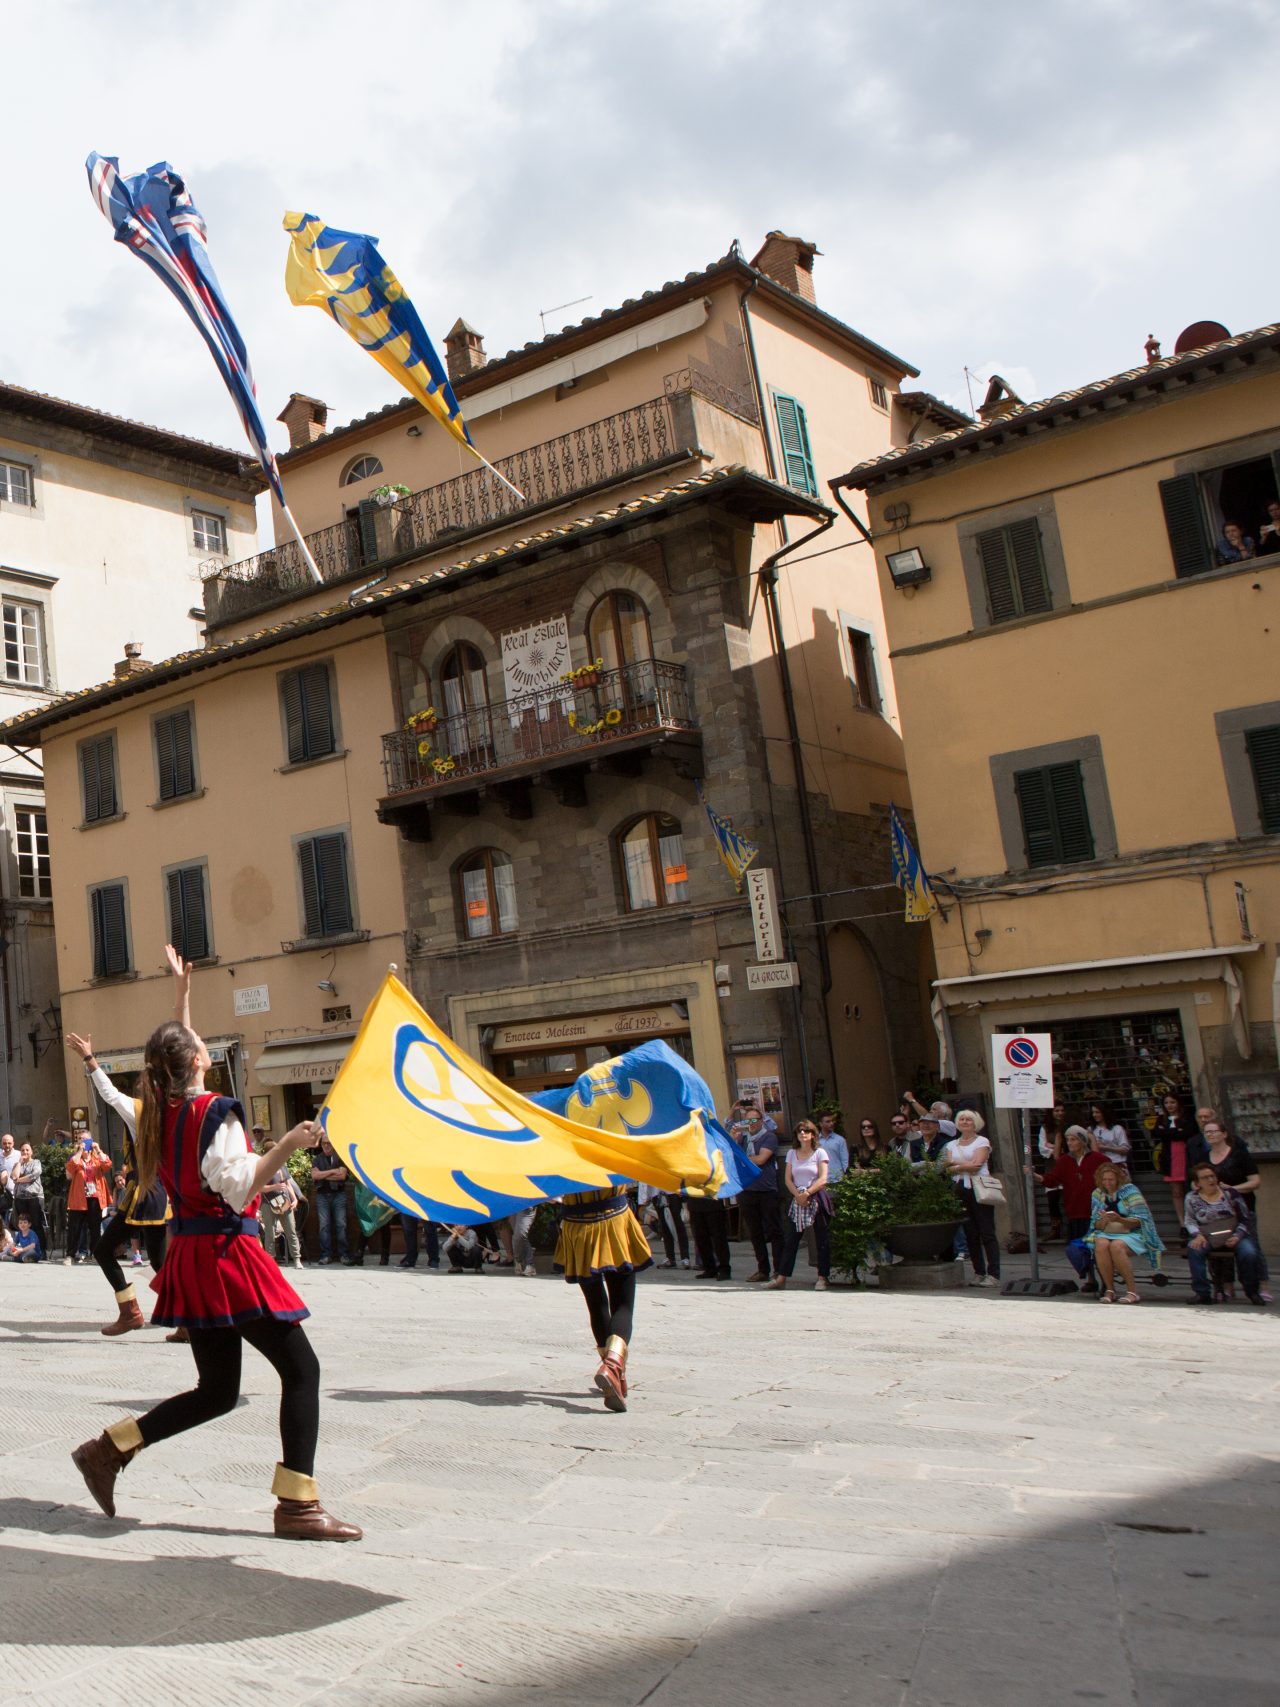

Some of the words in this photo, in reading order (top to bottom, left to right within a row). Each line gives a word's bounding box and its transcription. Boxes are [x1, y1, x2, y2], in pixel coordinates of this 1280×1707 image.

[504, 633, 528, 652] Real
[533, 622, 565, 644] Estate
[751, 873, 772, 957] Trattoria
[503, 1030, 541, 1043] Enoteca
[546, 1025, 586, 1039] Molesini
[635, 1016, 656, 1029] 1937
